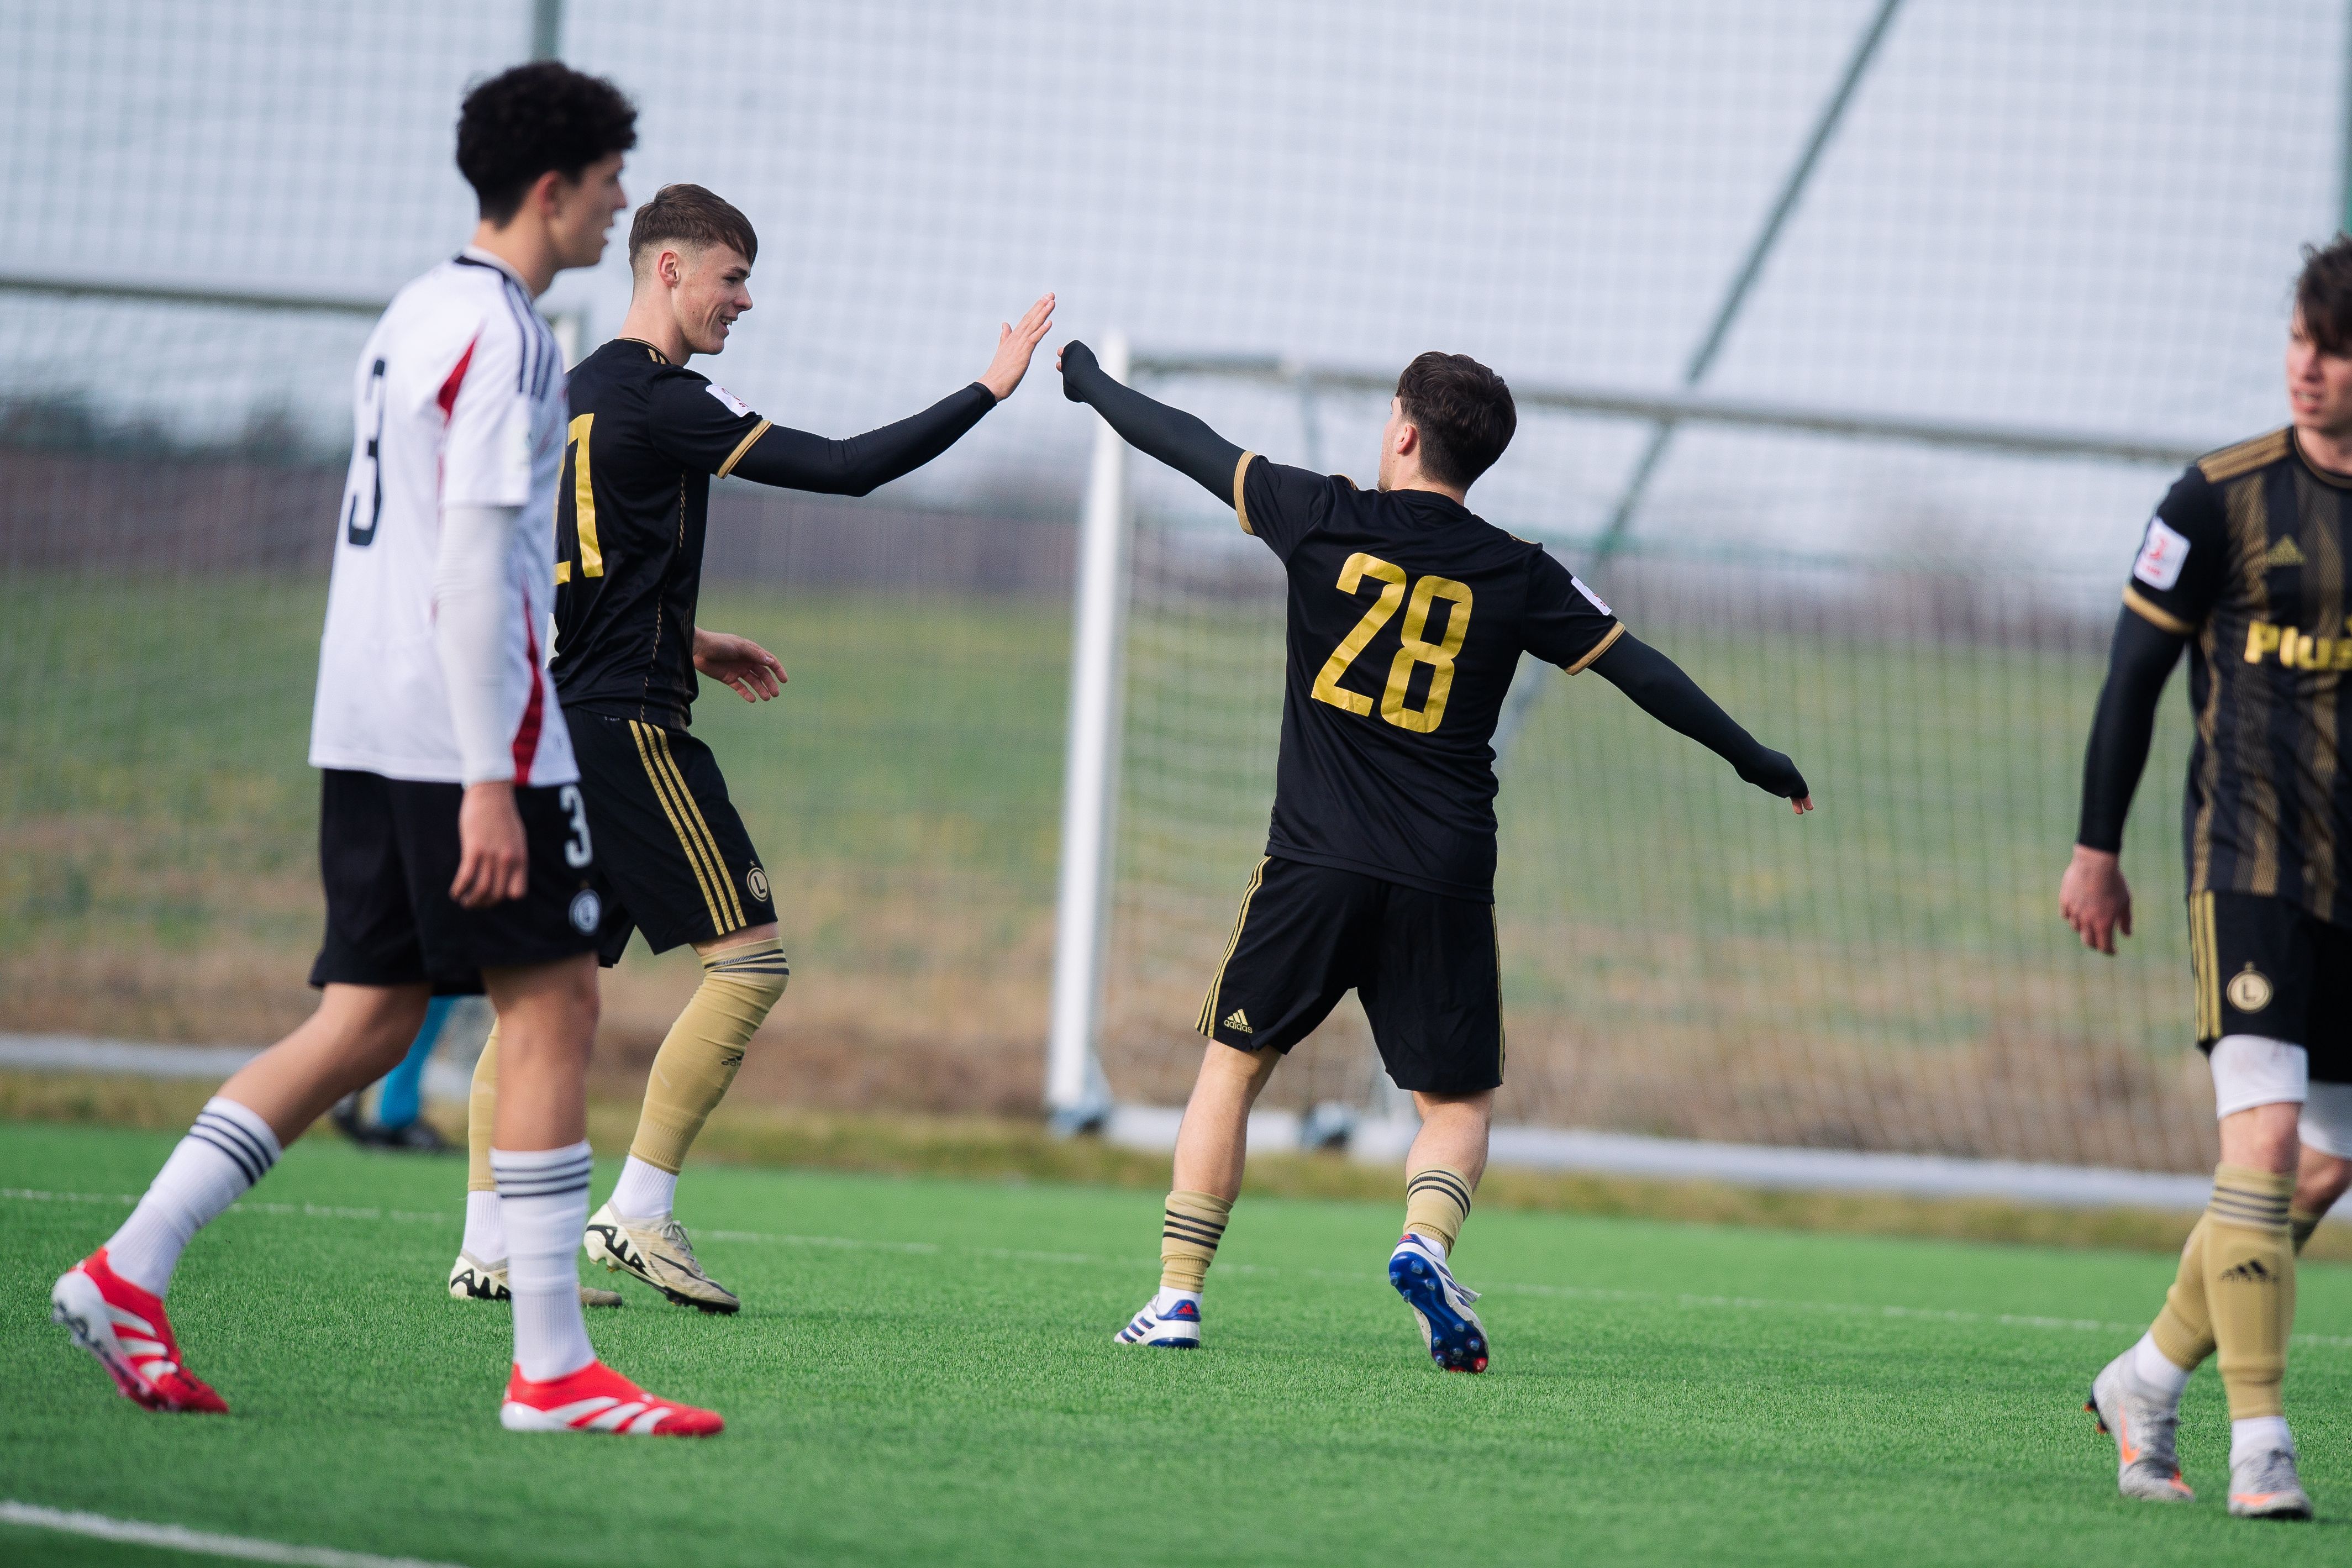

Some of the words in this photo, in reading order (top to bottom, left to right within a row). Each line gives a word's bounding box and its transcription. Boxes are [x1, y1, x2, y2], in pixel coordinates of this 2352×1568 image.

[348, 359, 386, 546] 3
[552, 413, 604, 587] 1
[1311, 553, 1473, 733] 28
[559, 784, 593, 869] 3
[1224, 1019, 1253, 1033] adidas
